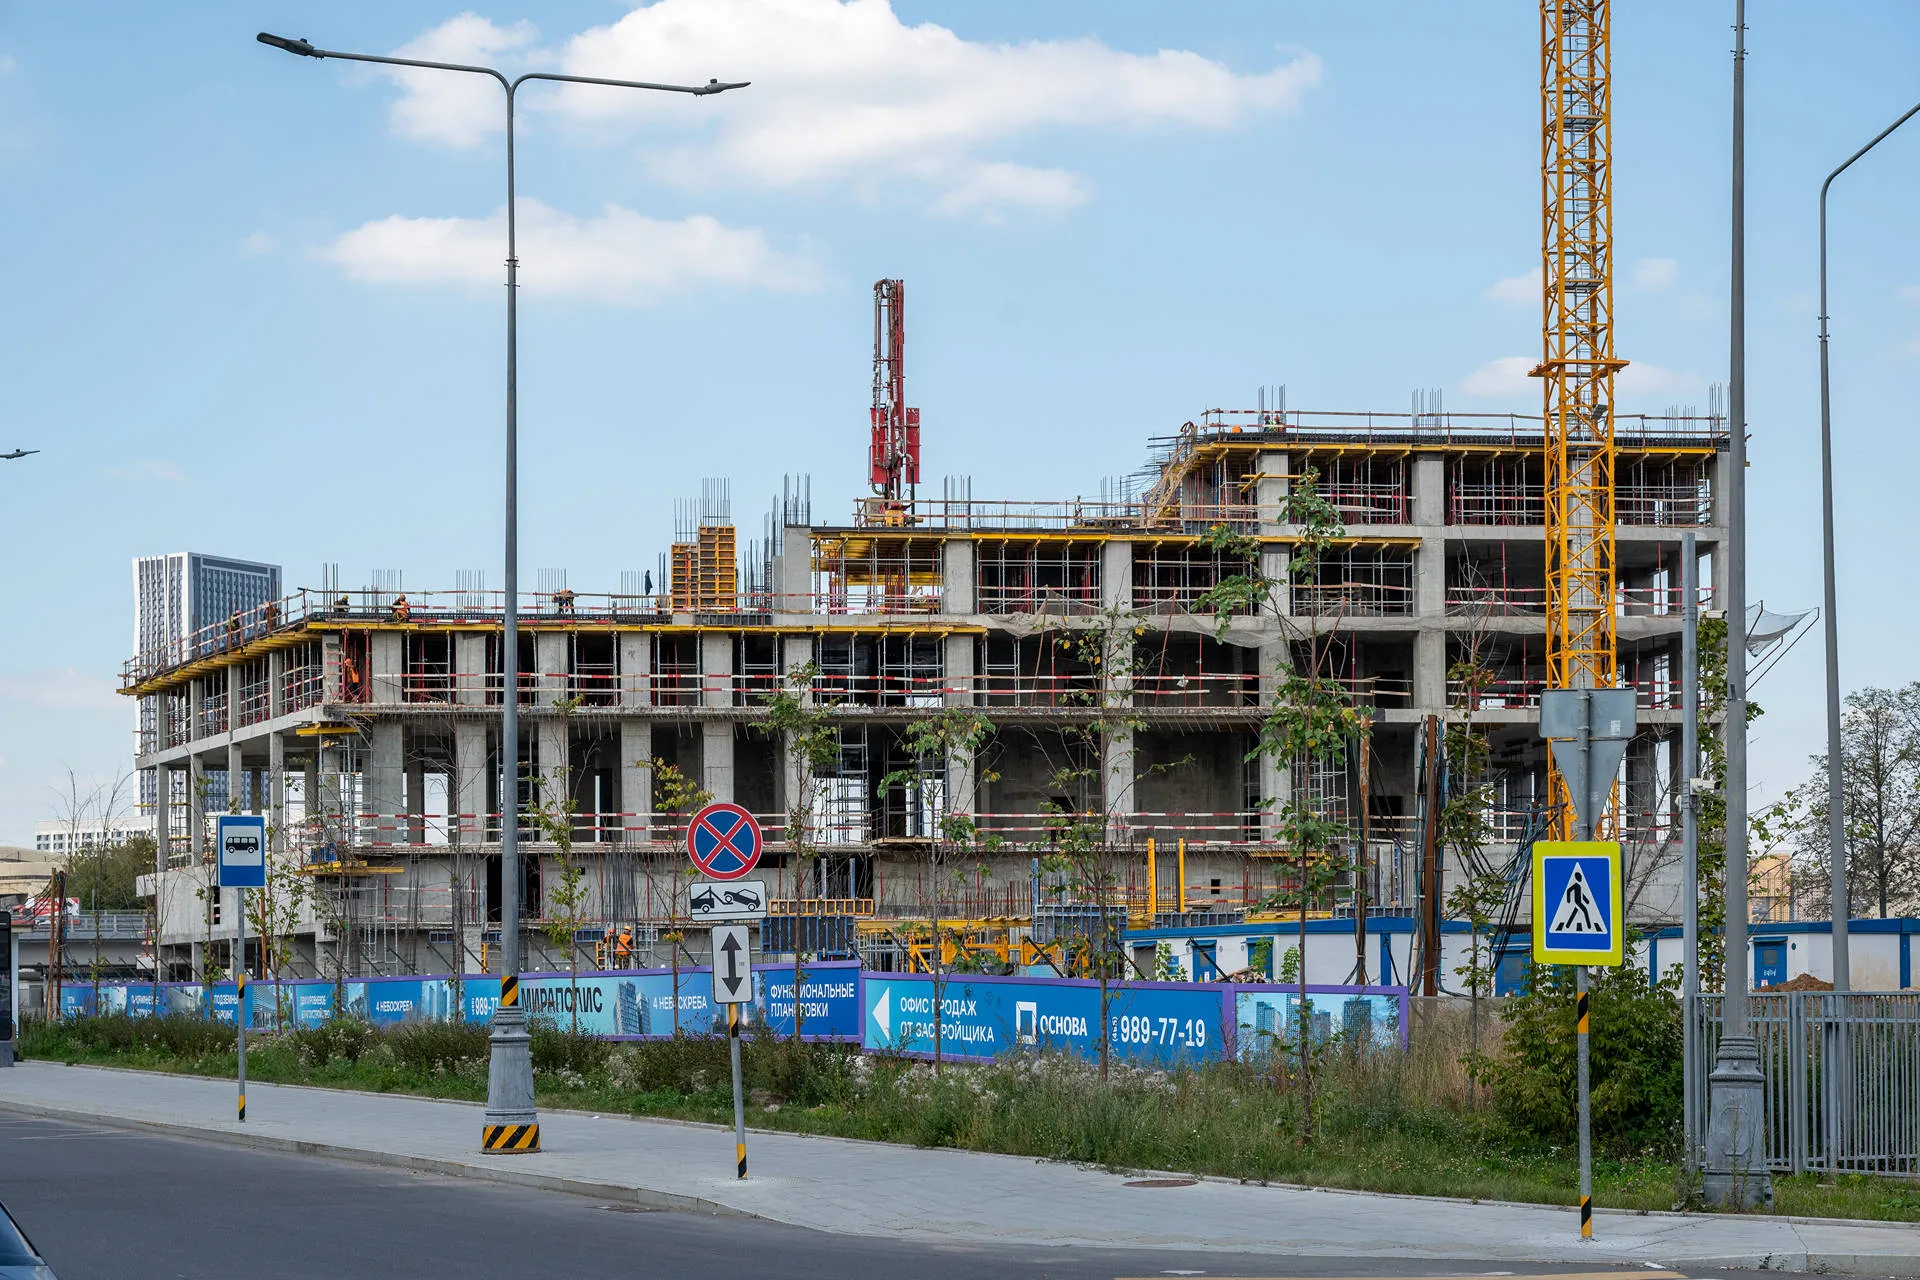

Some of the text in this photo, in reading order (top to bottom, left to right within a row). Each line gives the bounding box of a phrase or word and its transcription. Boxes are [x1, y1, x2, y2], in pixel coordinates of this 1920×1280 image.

[652, 995, 708, 1010] 4 НЕБСКРЕБА
[770, 1002, 829, 1018] ПЛАНРОВКИ
[900, 997, 928, 1014] ОФИС
[900, 1020, 995, 1044] ОТ ЗАСРОЙЩИКА
[1039, 1014, 1088, 1037] ОСНОВА
[1120, 1015, 1206, 1048] 989-77-19
